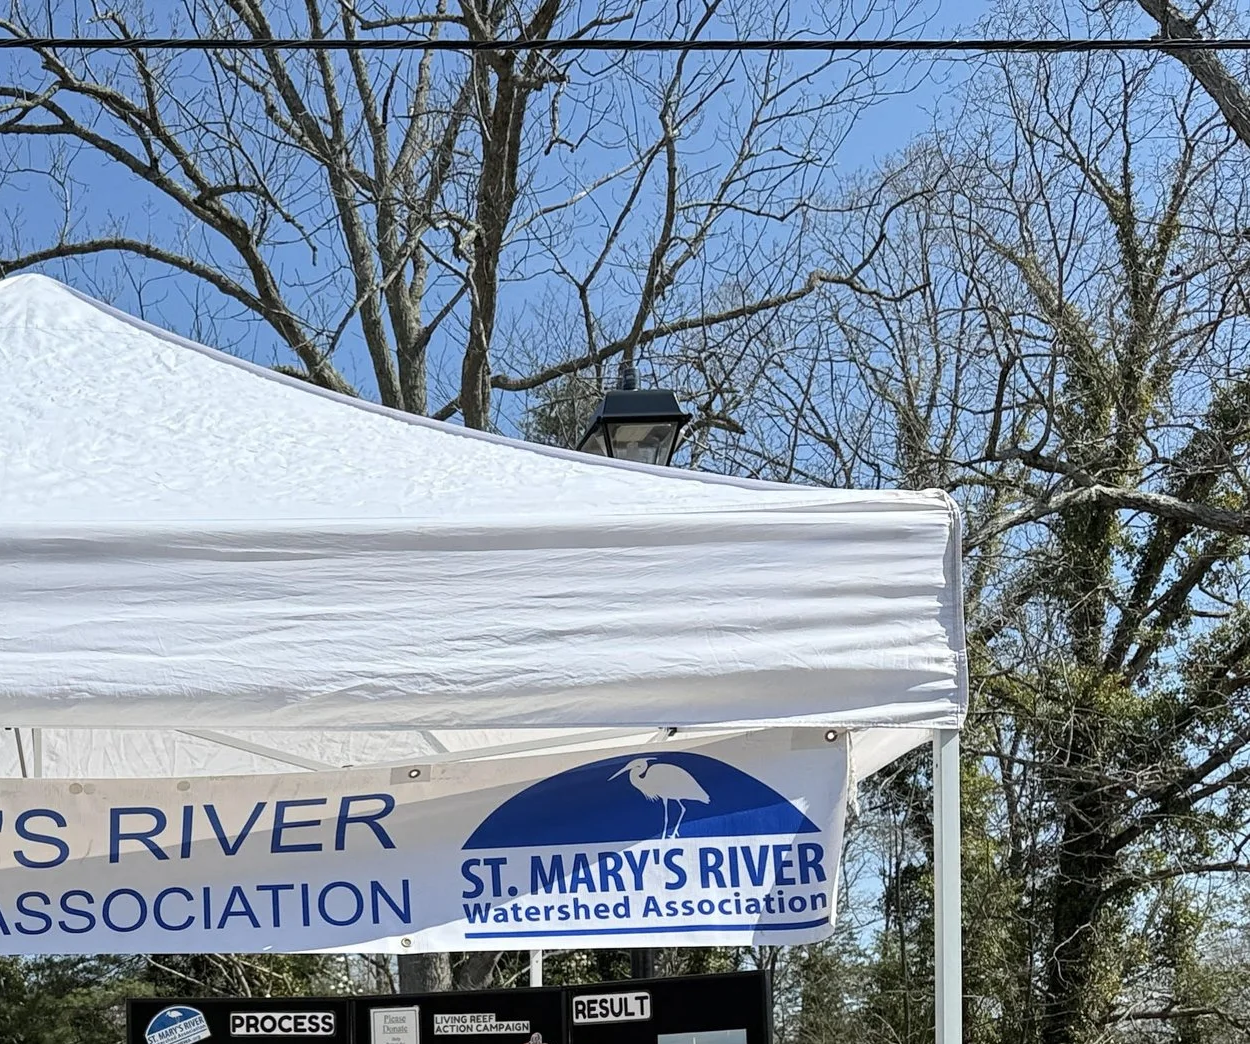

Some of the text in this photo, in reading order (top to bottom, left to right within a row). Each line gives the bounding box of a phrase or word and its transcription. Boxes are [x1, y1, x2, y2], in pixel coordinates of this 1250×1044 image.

[108, 793, 397, 863] RIVER
[460, 841, 828, 899] ST. MARY'S RIVER
[464, 889, 829, 924] Watershed Association
[574, 995, 649, 1020] RESULT
[147, 1016, 205, 1044] ST. MARY'S RIVER
[231, 1014, 334, 1033] PROCESS
[382, 1025, 408, 1033] Donate
[383, 1014, 406, 1024] Please
[434, 1014, 494, 1025] LIVING REEF
[435, 1023, 529, 1034] ACTION CAMPAIGN
